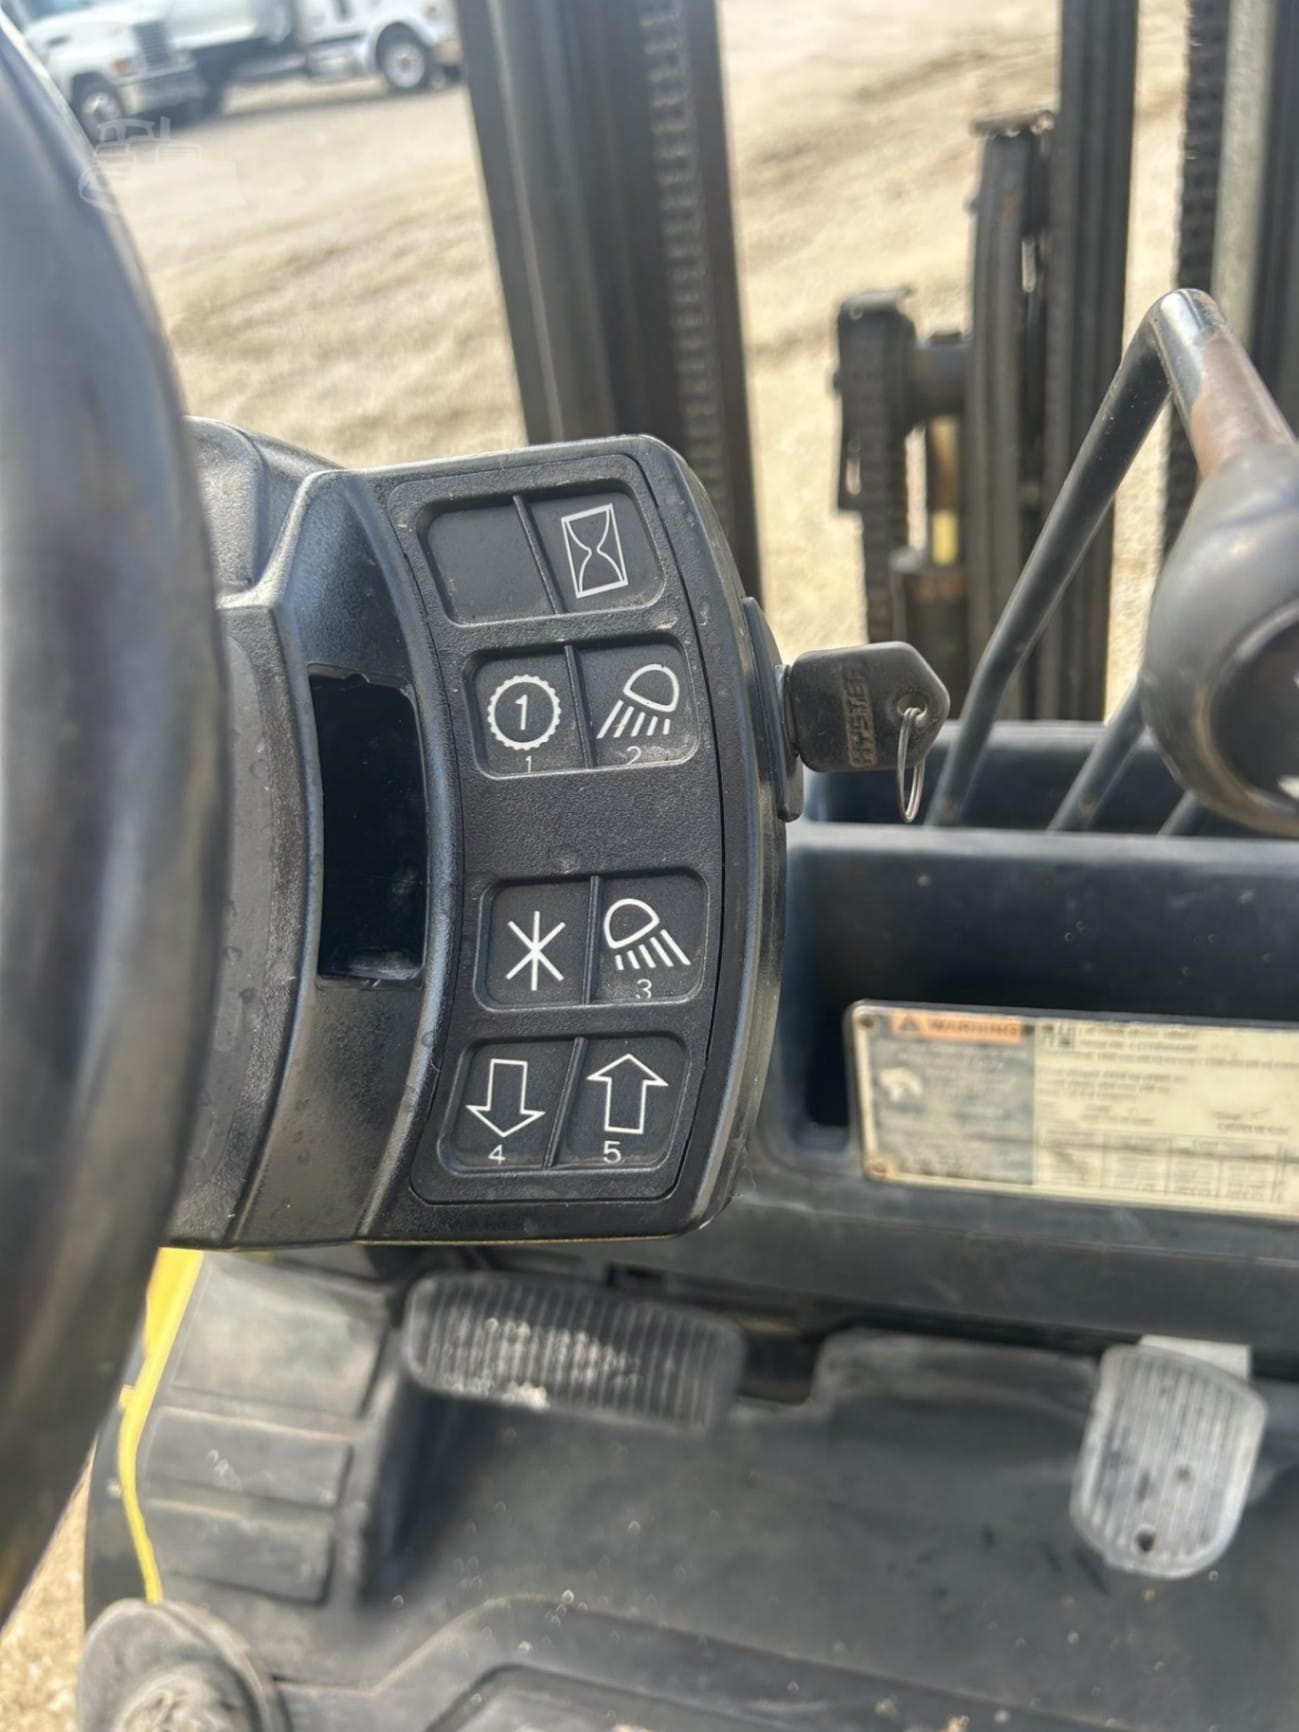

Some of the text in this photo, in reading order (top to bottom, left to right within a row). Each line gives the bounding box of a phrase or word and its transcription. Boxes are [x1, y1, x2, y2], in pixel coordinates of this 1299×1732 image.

[515, 694, 529, 731] 1
[841, 661, 874, 766] HYSTER
[525, 755, 533, 773] 1
[625, 745, 642, 767] 2
[636, 978, 652, 1000] 3
[488, 1144, 506, 1165] 4
[603, 1140, 622, 1164] 5
